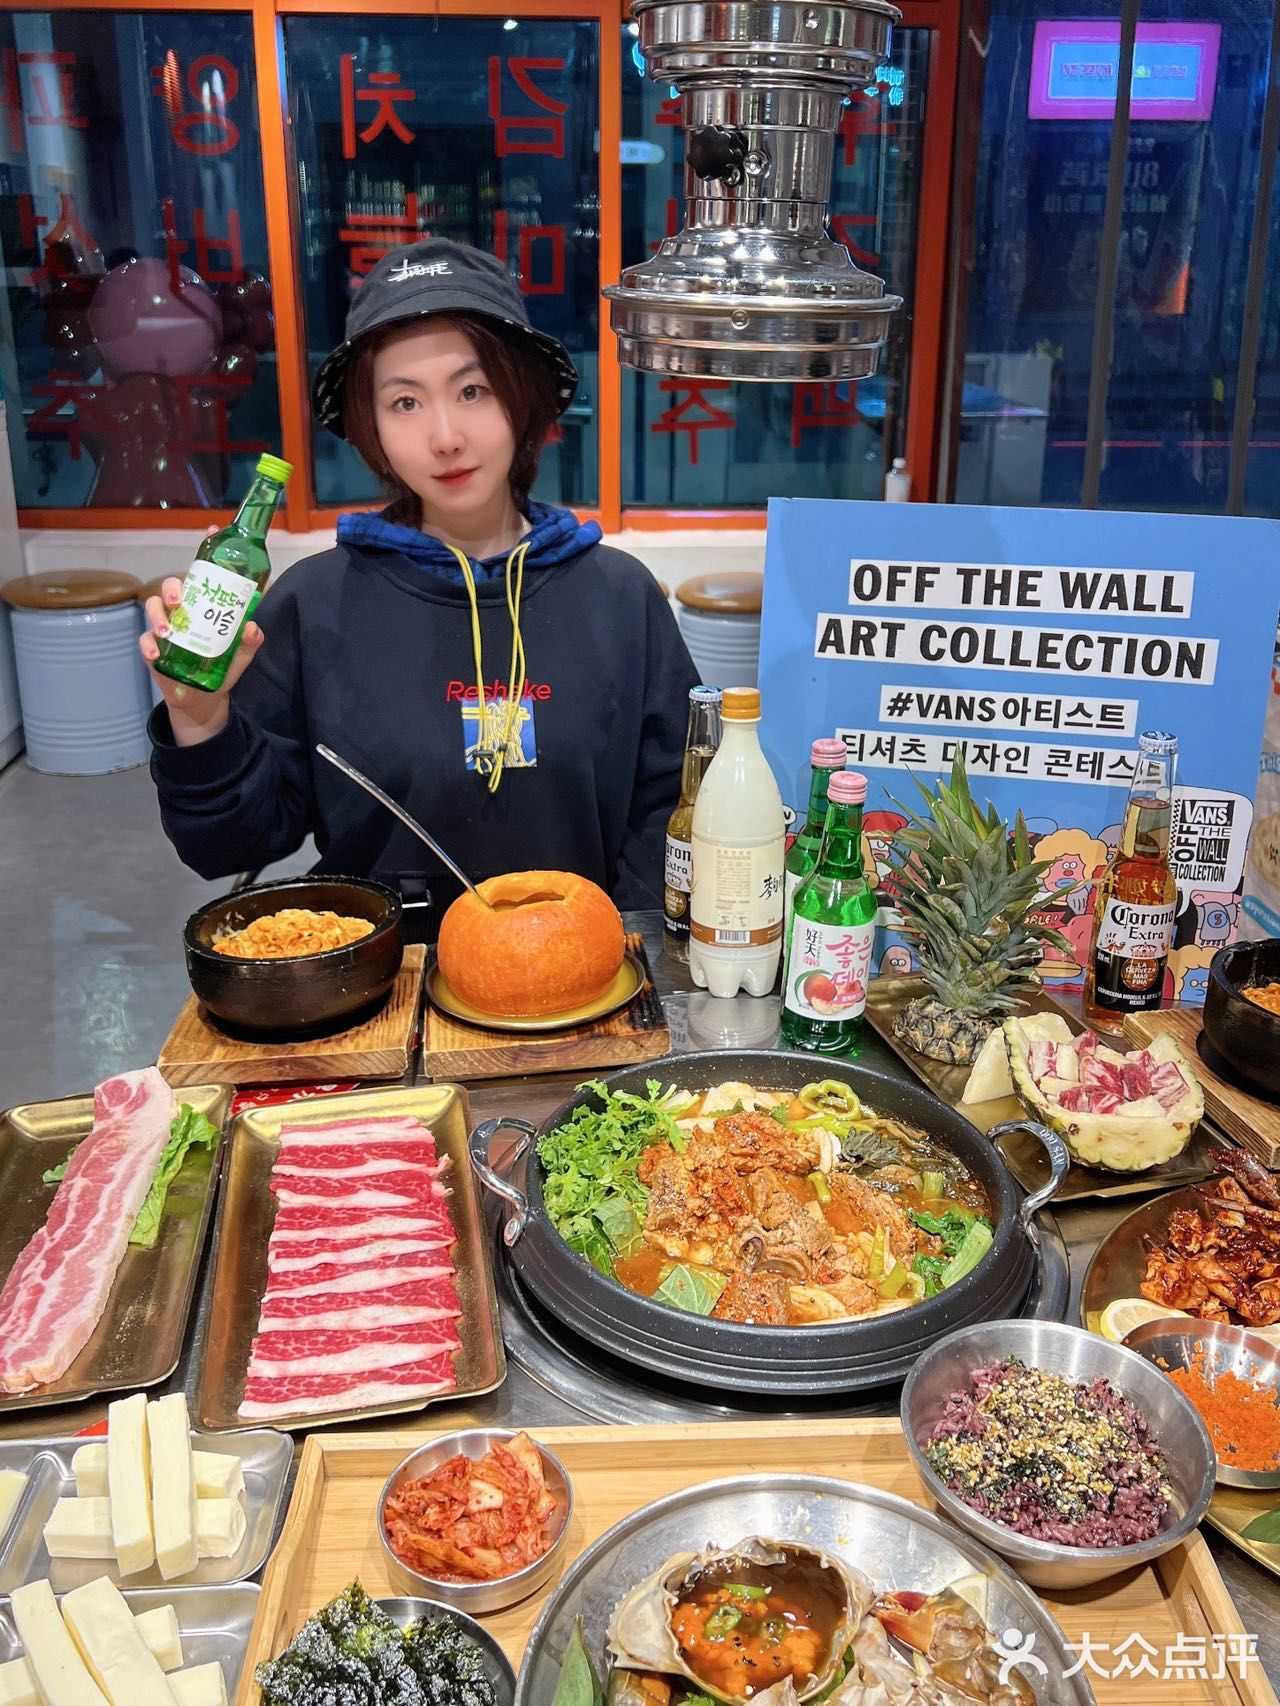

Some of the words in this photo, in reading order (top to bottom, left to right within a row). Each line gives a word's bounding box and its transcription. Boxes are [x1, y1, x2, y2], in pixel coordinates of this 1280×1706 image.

[853, 563, 940, 602] OFF
[956, 567, 1043, 607] THE
[1059, 571, 1185, 613] WALL
[204, 608, 235, 636] 이슬
[817, 618, 905, 657] ART
[920, 624, 1206, 679] COLLECTION
[1184, 800, 1228, 826] VANS
[1174, 825, 1199, 863] OFF
[1199, 826, 1232, 838] THE
[1198, 840, 1228, 862] WALL
[1178, 863, 1227, 883] COLLECTION
[1129, 926, 1164, 941] Extra
[825, 934, 872, 968] 좋은
